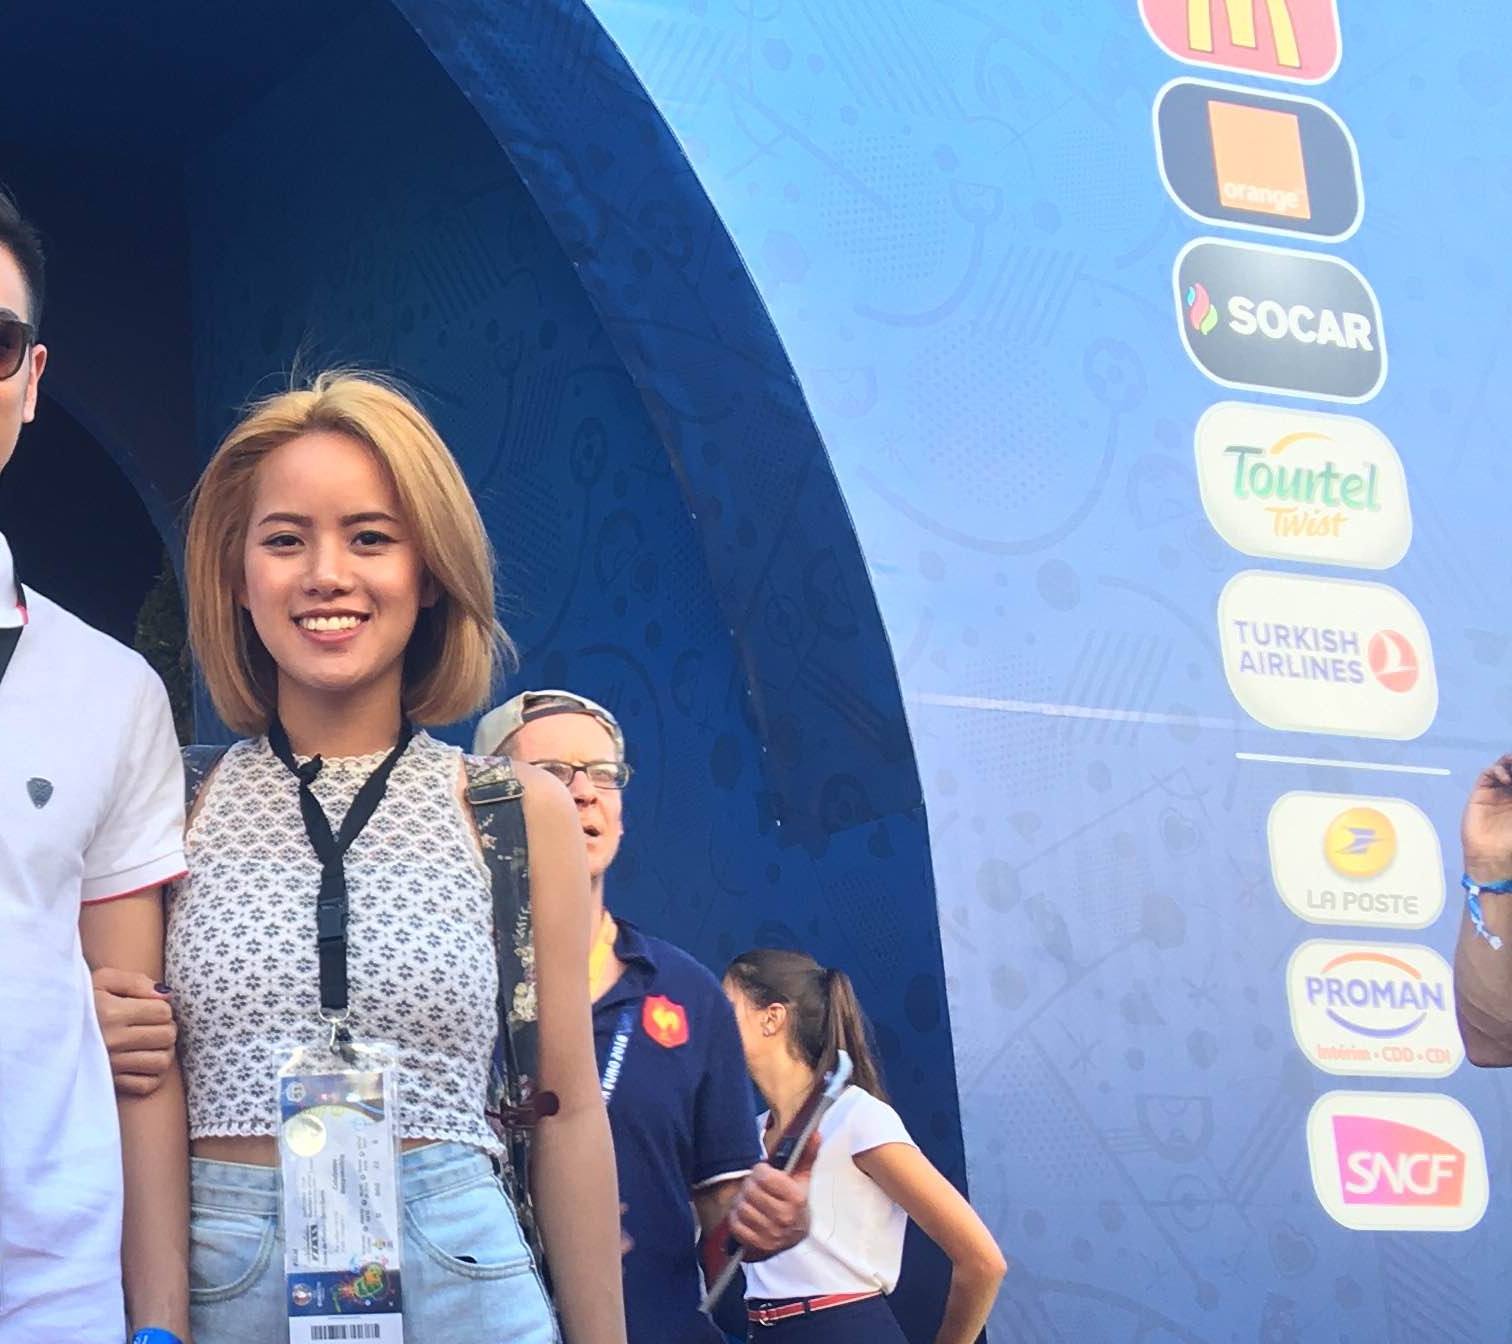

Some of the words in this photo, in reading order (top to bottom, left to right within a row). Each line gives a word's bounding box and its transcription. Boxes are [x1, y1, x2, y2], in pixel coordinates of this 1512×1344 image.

[1223, 181, 1302, 212] orange
[1228, 295, 1374, 352] SOCAR
[1224, 445, 1381, 513] Tourtel
[1264, 506, 1349, 538] Twist
[1233, 620, 1360, 657] TURKISH
[1239, 650, 1365, 685] AIRLINES
[1306, 889, 1337, 910] LA
[1342, 891, 1420, 915] POSTE
[1304, 976, 1446, 1011] PROMAN
[1345, 1151, 1457, 1195] SNCF
